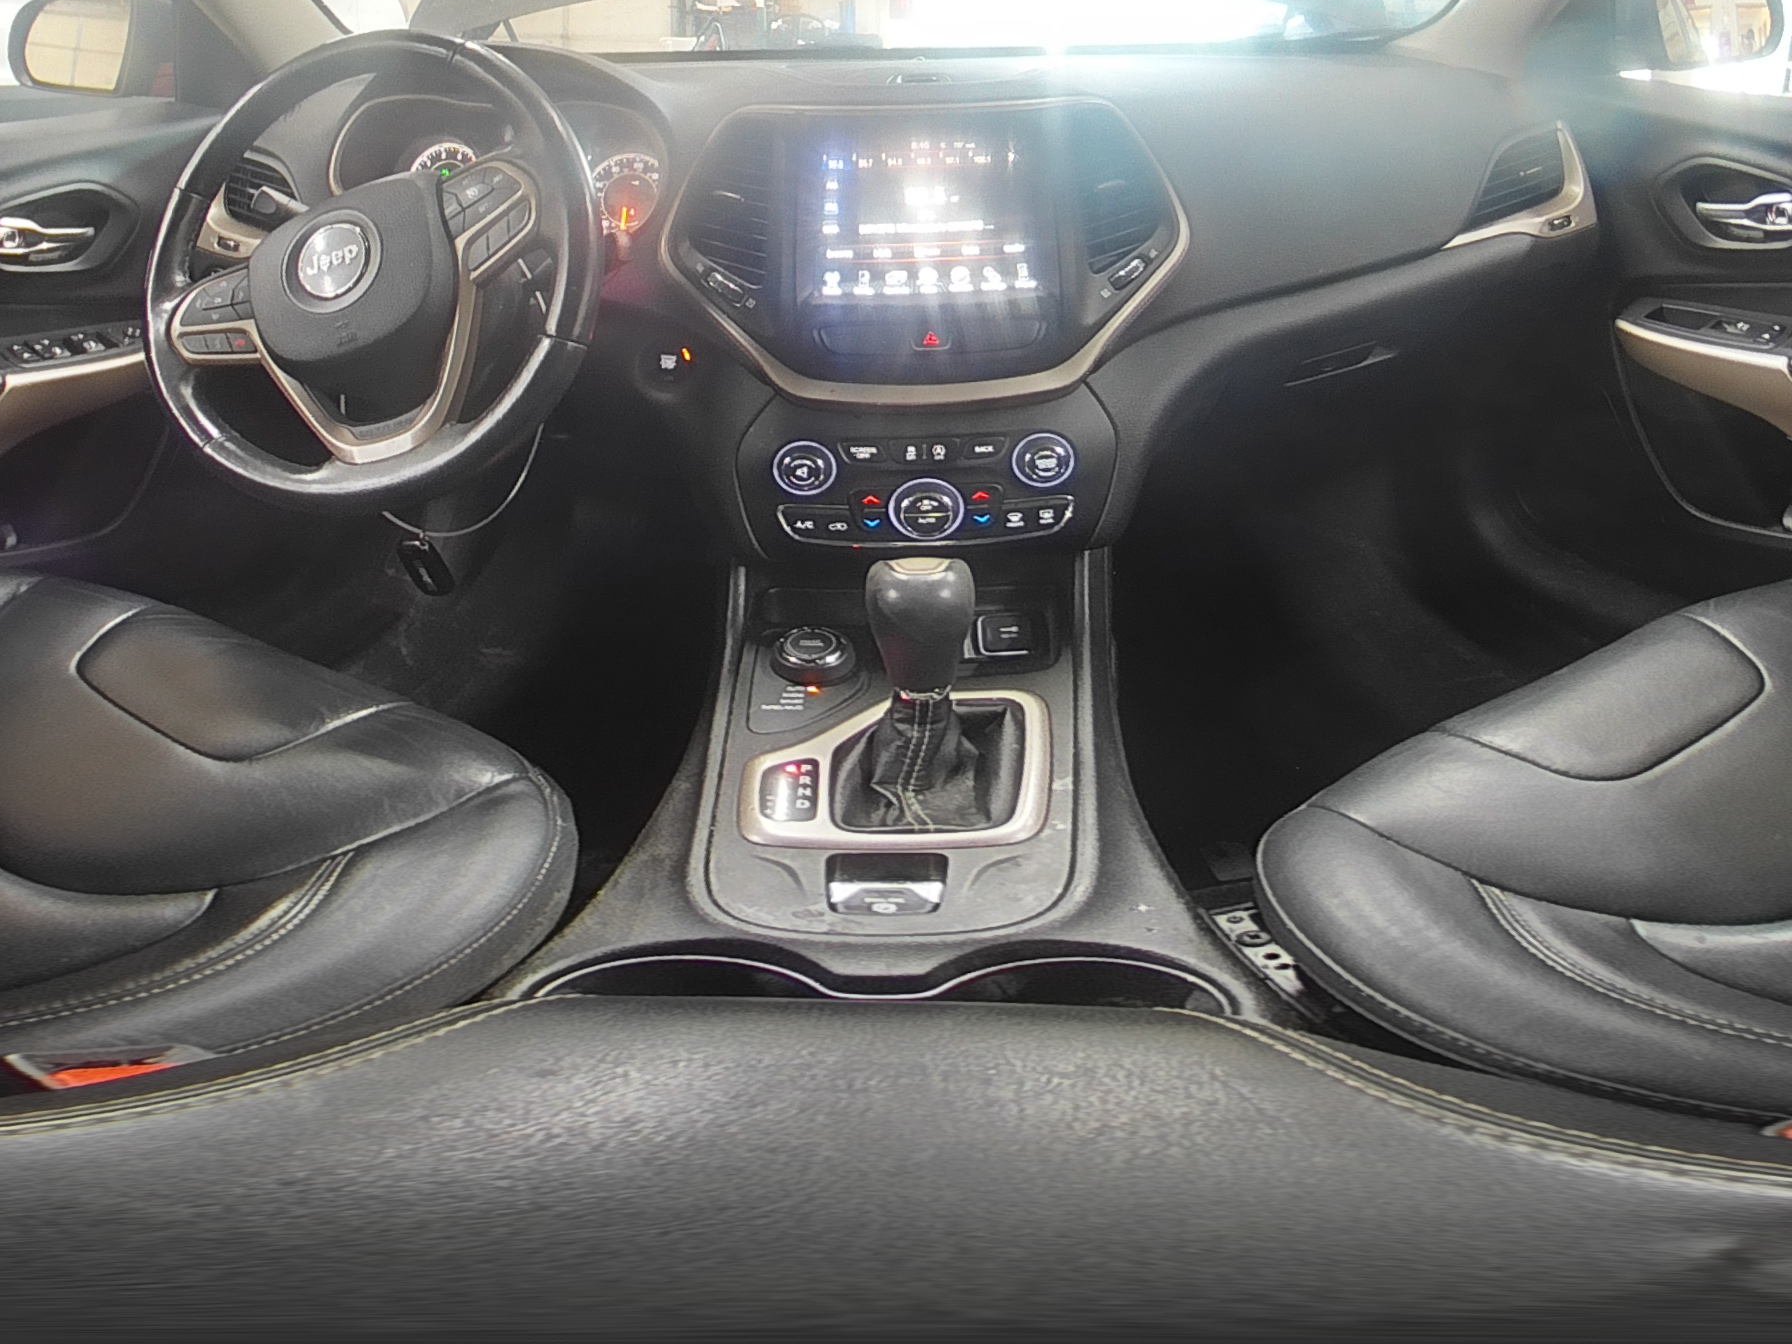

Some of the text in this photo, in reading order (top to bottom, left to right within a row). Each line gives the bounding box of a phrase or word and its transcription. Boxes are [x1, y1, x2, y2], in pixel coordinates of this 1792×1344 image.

[306, 244, 359, 276] Jeep
[799, 775, 812, 785] R
[797, 787, 812, 796] N
[796, 799, 811, 808] D
